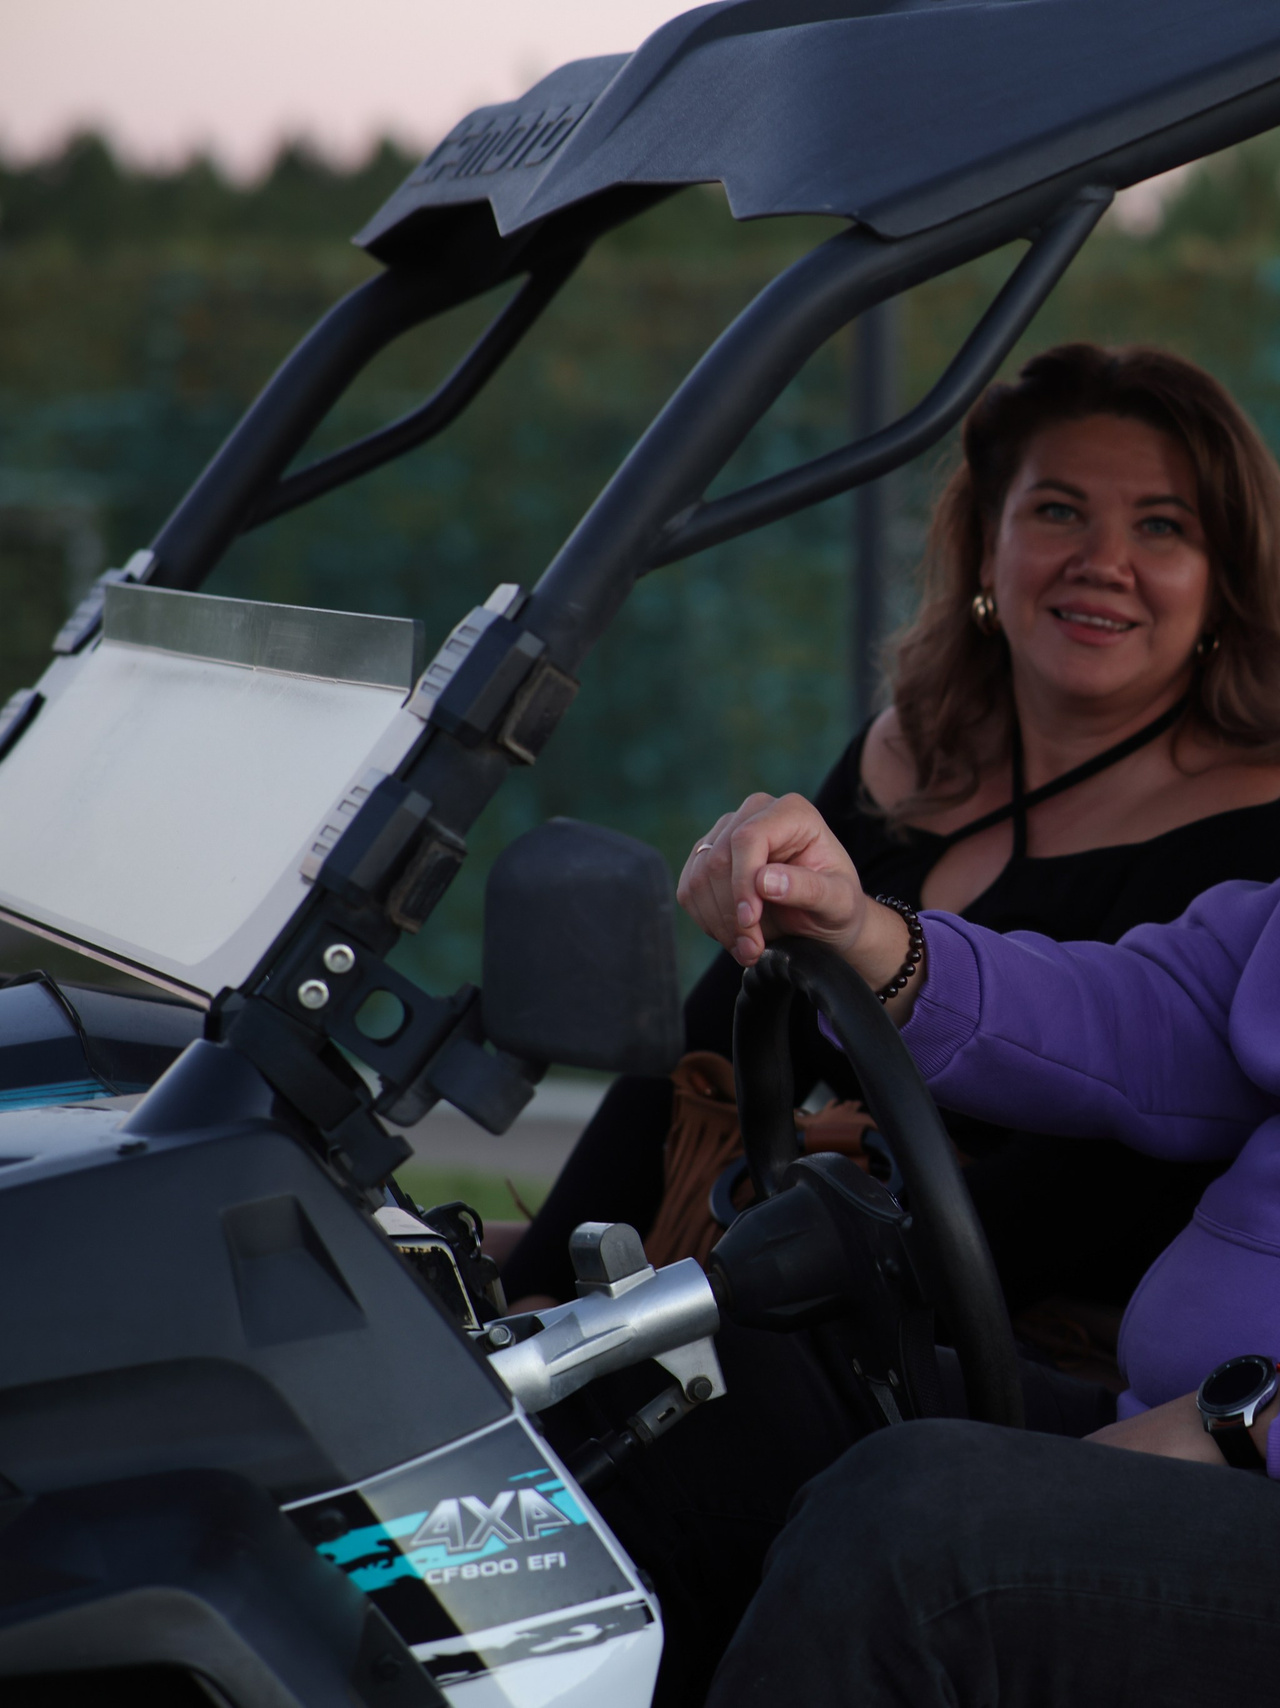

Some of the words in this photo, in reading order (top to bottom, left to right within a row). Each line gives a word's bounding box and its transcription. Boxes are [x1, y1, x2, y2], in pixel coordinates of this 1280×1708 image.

[410, 1488, 571, 1552] AXA
[425, 1558, 518, 1585] CF800
[527, 1552, 567, 1572] EFI
